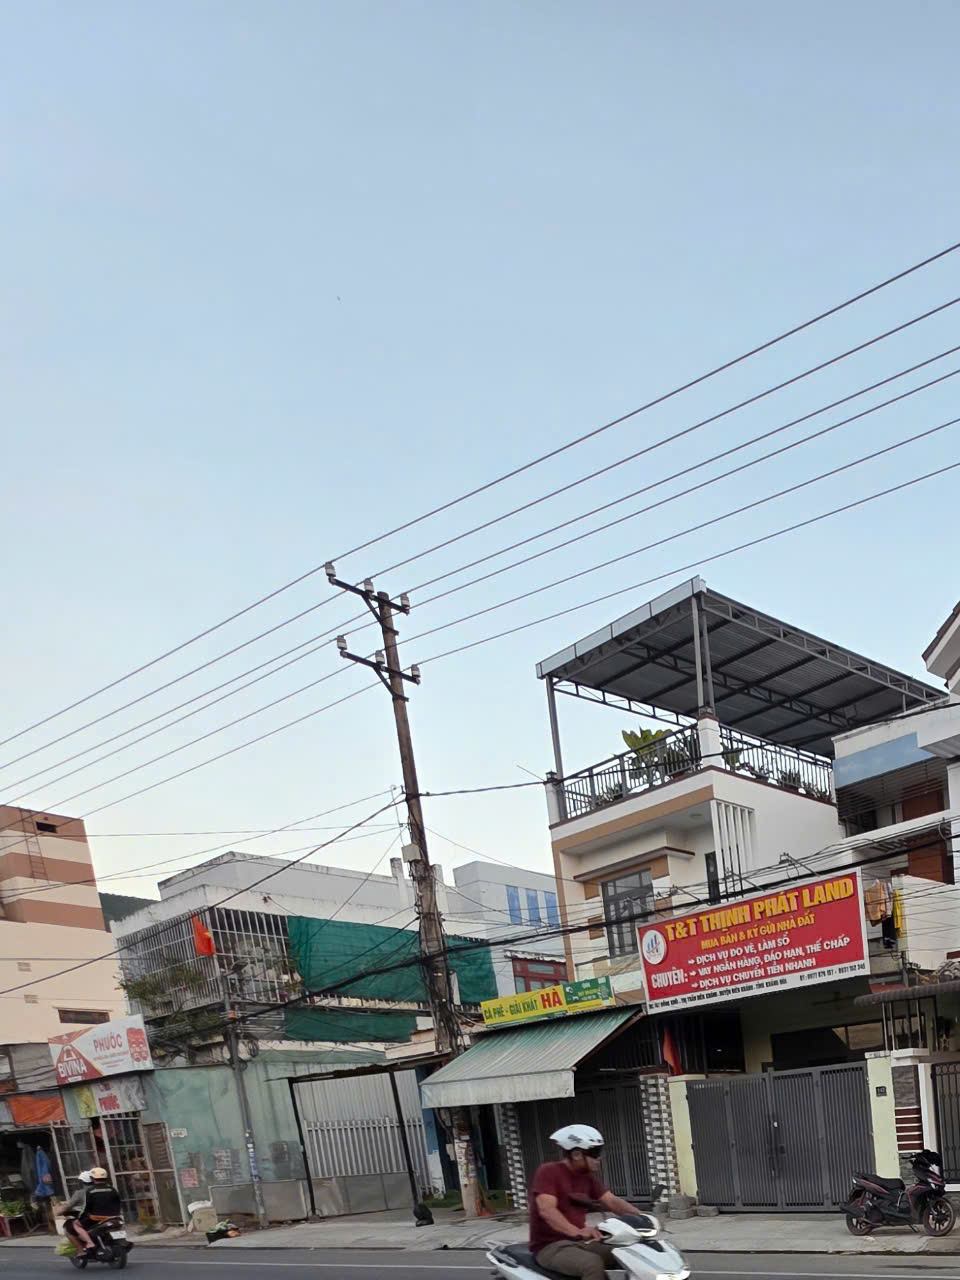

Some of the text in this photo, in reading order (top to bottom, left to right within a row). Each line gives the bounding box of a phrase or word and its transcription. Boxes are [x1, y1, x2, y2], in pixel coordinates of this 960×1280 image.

[664, 878, 854, 942] T&T THỊNH PHÁT LAND
[701, 937, 719, 950] MUA
[747, 925, 759, 939] KÝ
[777, 916, 796, 931] NHÀ
[797, 911, 815, 927] ĐẤT
[696, 952, 716, 966] DỊCH
[718, 950, 729, 960] VỤ
[730, 947, 743, 958] ĐO
[758, 938, 776, 951] LÀM
[698, 966, 712, 976] VAY
[806, 938, 822, 953] THẾ
[823, 934, 850, 950] CHẤP
[651, 966, 688, 989] CHUYÊN:
[699, 976, 719, 990] DỊCH
[720, 973, 731, 985] VỤ
[785, 958, 816, 972] NHANH
[540, 988, 563, 1009] HÀ
[58, 1059, 88, 1077] BIVINA
